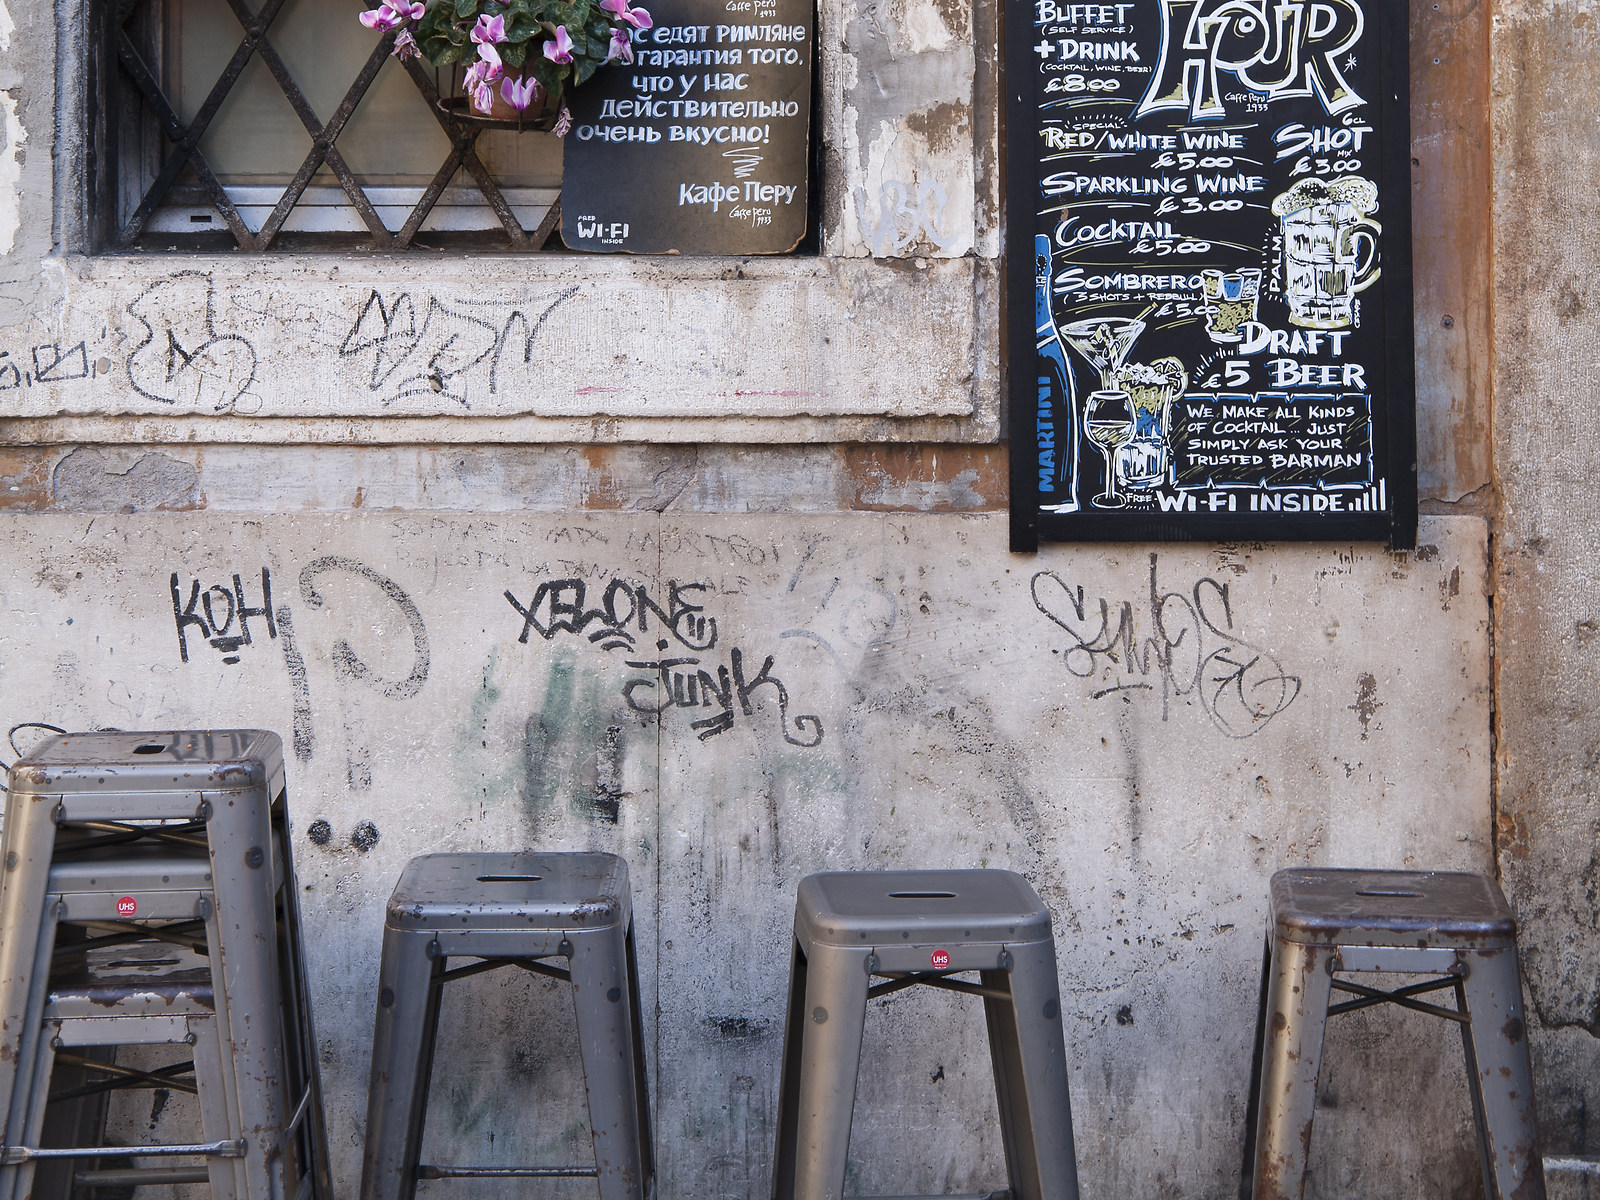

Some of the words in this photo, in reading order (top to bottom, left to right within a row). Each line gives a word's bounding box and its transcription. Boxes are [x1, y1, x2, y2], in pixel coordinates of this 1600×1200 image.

[760, 9, 777, 18] 1933
[652, 26, 710, 45] едят
[716, 24, 808, 45] римляне
[637, 48, 742, 69] гарантия
[747, 48, 804, 67] того,
[633, 75, 675, 93] что
[678, 74, 698, 98] у
[703, 72, 750, 92] нас
[1043, 73, 1121, 94] €8.00
[1245, 103, 1269, 112] 1933
[576, 124, 662, 144] очень
[668, 124, 771, 145] вкусно!
[1072, 122, 1121, 131] SPECIAL
[1039, 126, 1178, 150] RED/WHITE
[1182, 130, 1246, 150] WINE
[1274, 123, 1374, 159] SHOT
[1040, 170, 1188, 197] SPARKLING
[1195, 172, 1265, 195] WINE
[678, 181, 741, 213] Кафе
[742, 181, 798, 206] Перу
[577, 221, 630, 238] WI-FI
[1054, 215, 1182, 248] COCKTAIL
[1128, 238, 1212, 257] €5.00
[1269, 235, 1284, 293] PALM
[1053, 267, 1205, 293] SOMBRERO
[1237, 321, 1352, 357] DRAFT
[1265, 358, 1367, 391] BEER
[1186, 404, 1215, 419] WE
[1222, 405, 1270, 419] MAKE
[1275, 405, 1302, 419] ALL
[1308, 405, 1356, 419] KINDS
[1036, 376, 1056, 493] MARTINI
[1186, 422, 1208, 435] OF
[1306, 422, 1347, 436] JUST
[1187, 438, 1251, 451] SIMPLY
[1256, 438, 1289, 451] ASK
[1296, 438, 1343, 450] YOUR
[1186, 453, 1264, 466] TRUSTED
[1268, 452, 1362, 469] BARMAN
[1125, 492, 1153, 503] FREE
[1156, 490, 1238, 512] WI-FI
[1249, 492, 1346, 512] INSIDE
[118, 902, 135, 911] UHS
[932, 955, 948, 964] UHS
